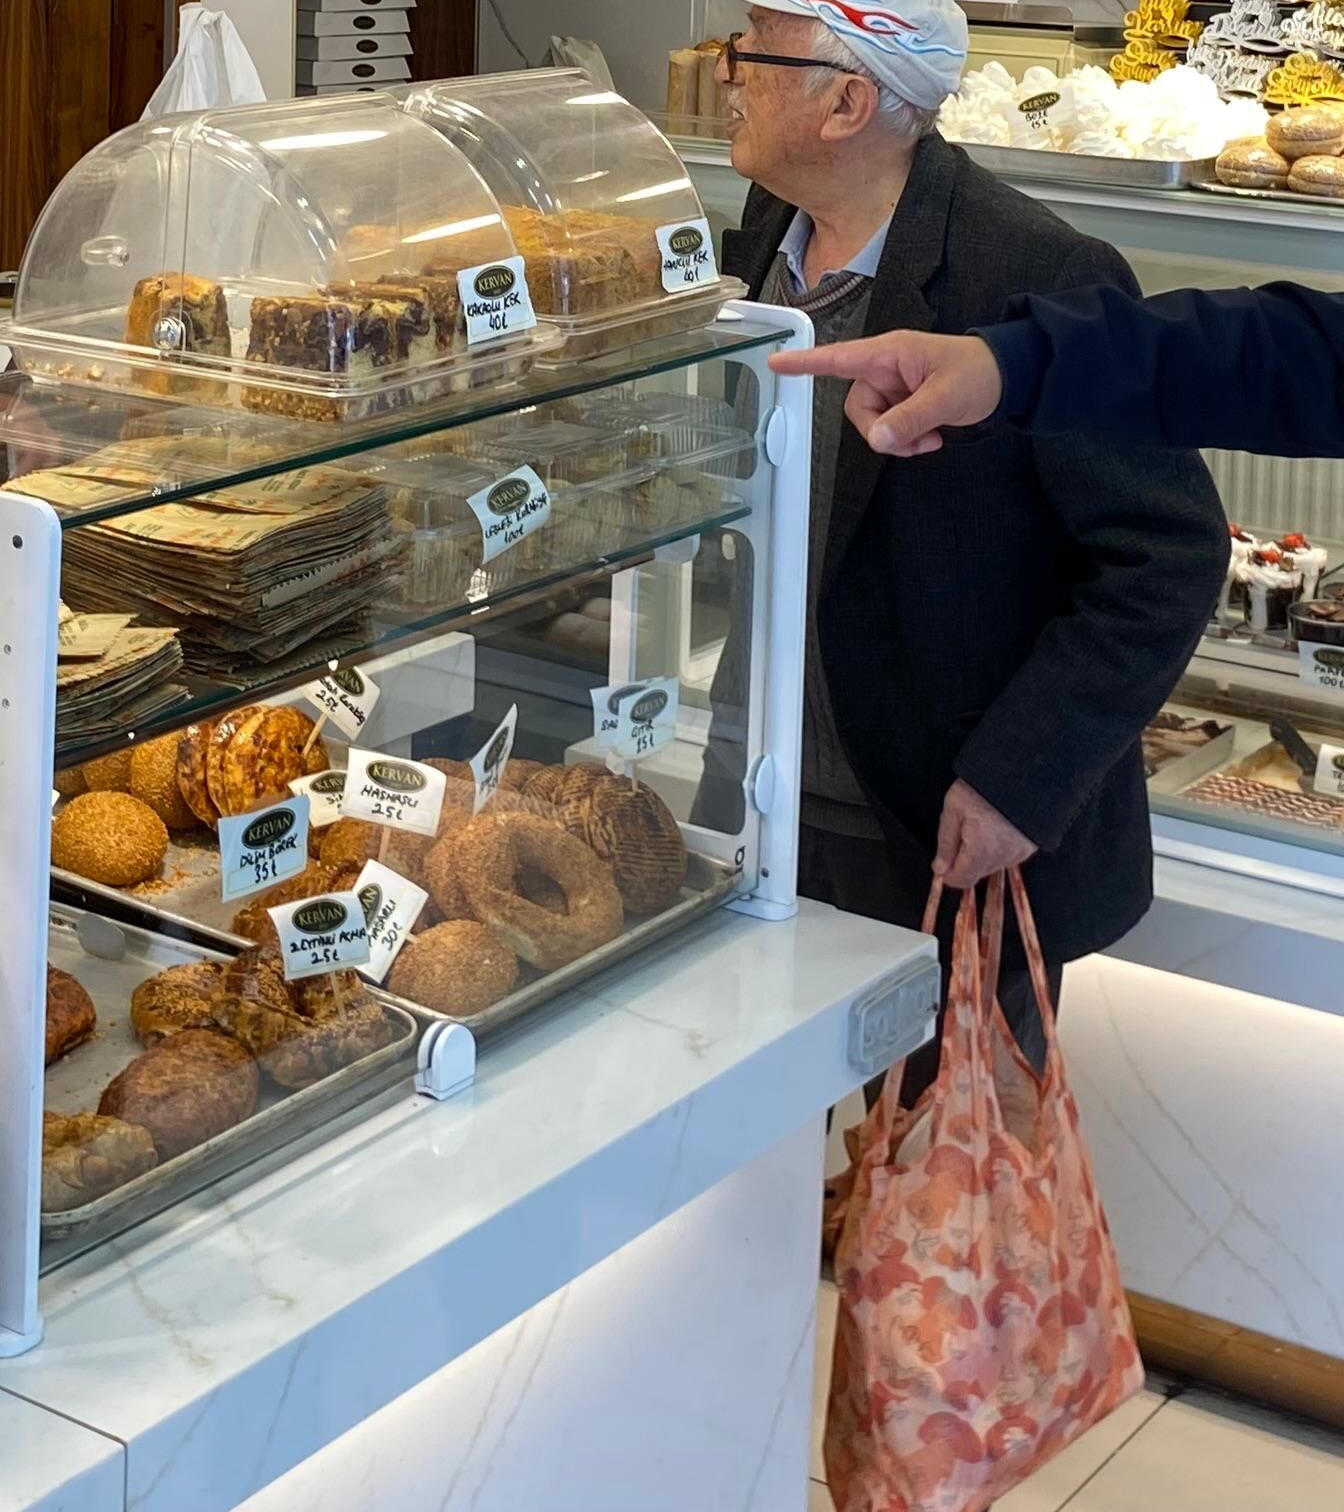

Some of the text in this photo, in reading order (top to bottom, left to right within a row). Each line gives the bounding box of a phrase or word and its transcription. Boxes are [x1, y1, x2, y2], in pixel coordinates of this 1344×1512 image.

[1022, 94, 1057, 110] KERVAN
[672, 234, 700, 248] KERVAN
[477, 271, 512, 292] KERVAN
[467, 291, 521, 317] KAKAOLU KEK
[491, 482, 527, 508] KERVAN
[316, 777, 344, 791] KERV
[373, 764, 423, 786] KERVAN
[248, 814, 291, 842] KERVAN
[298, 906, 344, 926] KERVAN
